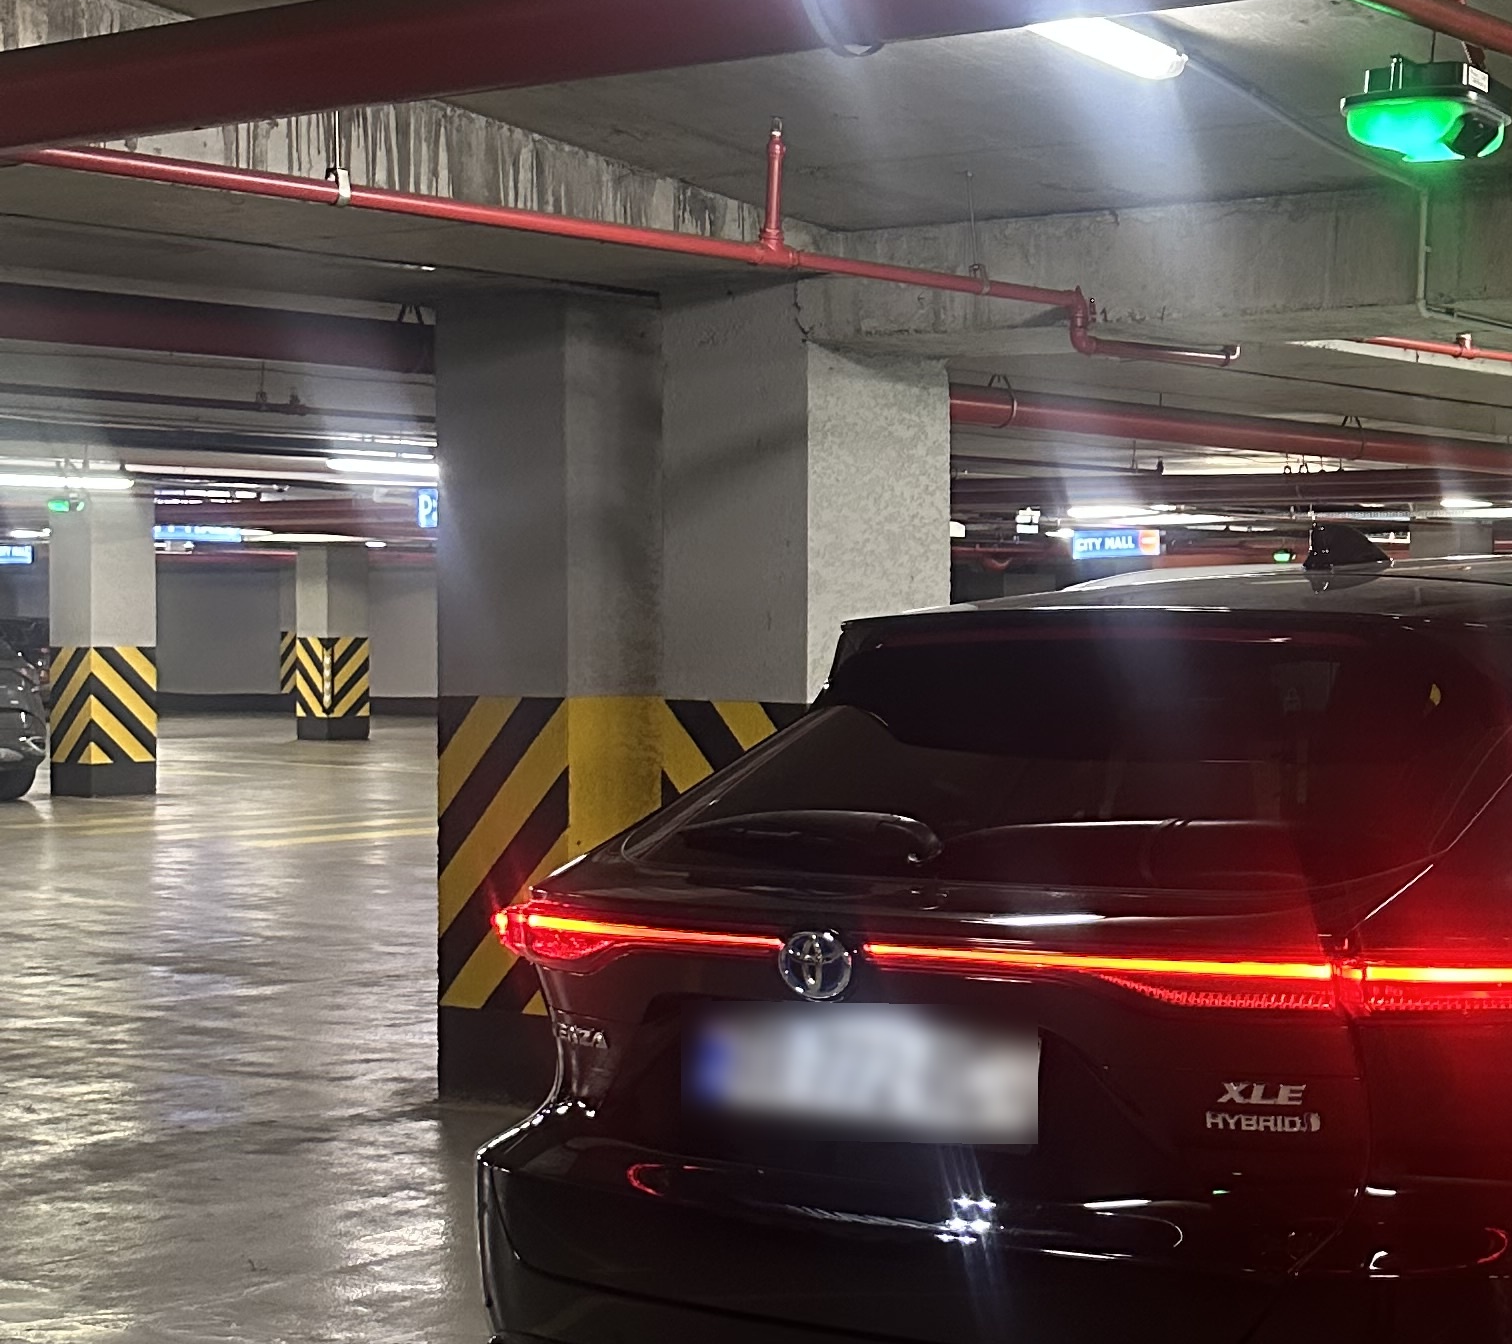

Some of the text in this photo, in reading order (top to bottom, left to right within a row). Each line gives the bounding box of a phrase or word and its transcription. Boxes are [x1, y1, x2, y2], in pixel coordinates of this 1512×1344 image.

[418, 494, 432, 527] P
[1075, 535, 1135, 552] CITY MALL
[556, 1022, 608, 1049] ENZA
[1217, 1082, 1307, 1105] XLE
[1205, 1111, 1302, 1133] HYBRID
